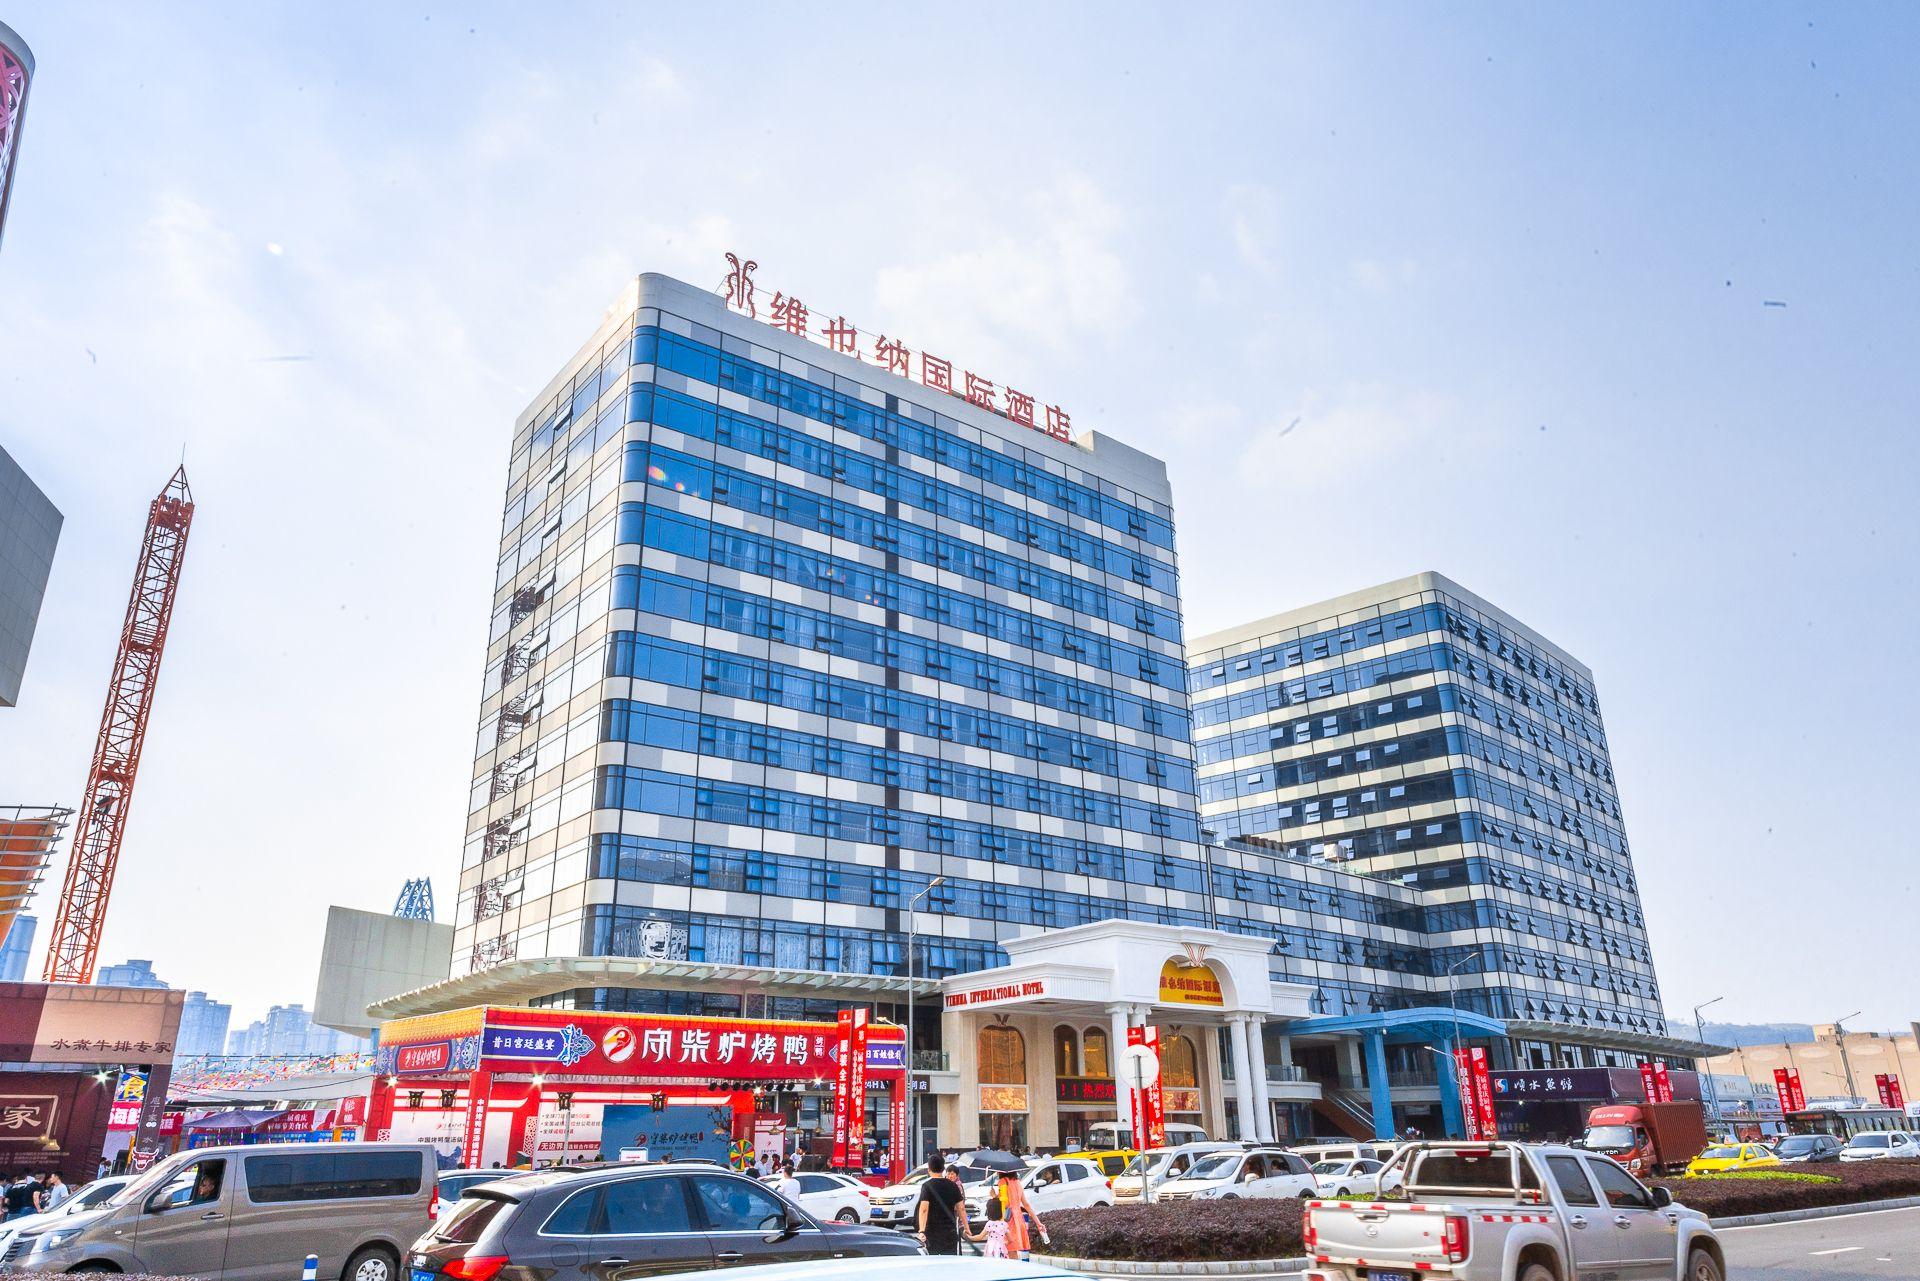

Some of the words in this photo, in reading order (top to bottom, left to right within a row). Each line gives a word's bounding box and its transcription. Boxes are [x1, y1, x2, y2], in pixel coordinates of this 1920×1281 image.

[770, 291, 1071, 443] 维也纳国际酒店
[945, 993, 967, 1007] VIENNA
[970, 984, 1020, 1004] INTERNATIONAL
[1022, 981, 1044, 996] HOTEL
[51, 1038, 172, 1053] 水煮牛排专家
[493, 1037, 555, 1051] 昔日宫廷盛宴
